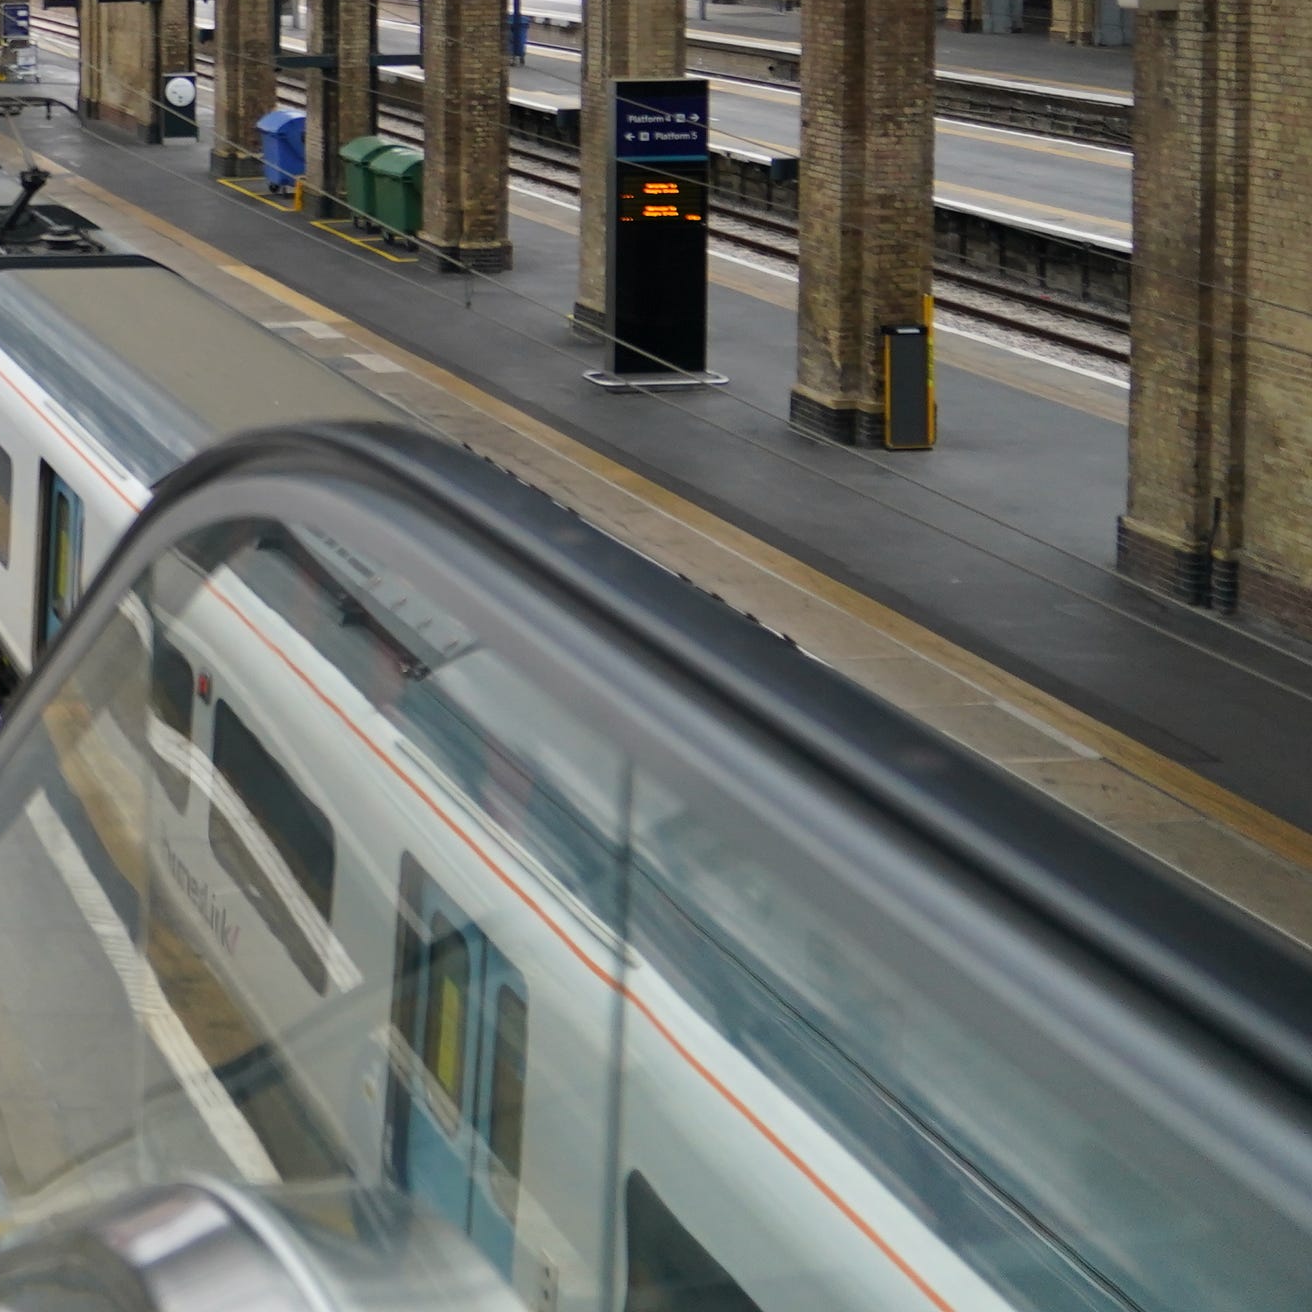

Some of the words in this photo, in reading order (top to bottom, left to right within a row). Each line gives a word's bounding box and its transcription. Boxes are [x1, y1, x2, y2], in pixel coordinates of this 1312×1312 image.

[628, 114, 665, 124] Platform
[655, 131, 691, 141] Platform
[690, 131, 699, 141] 5
